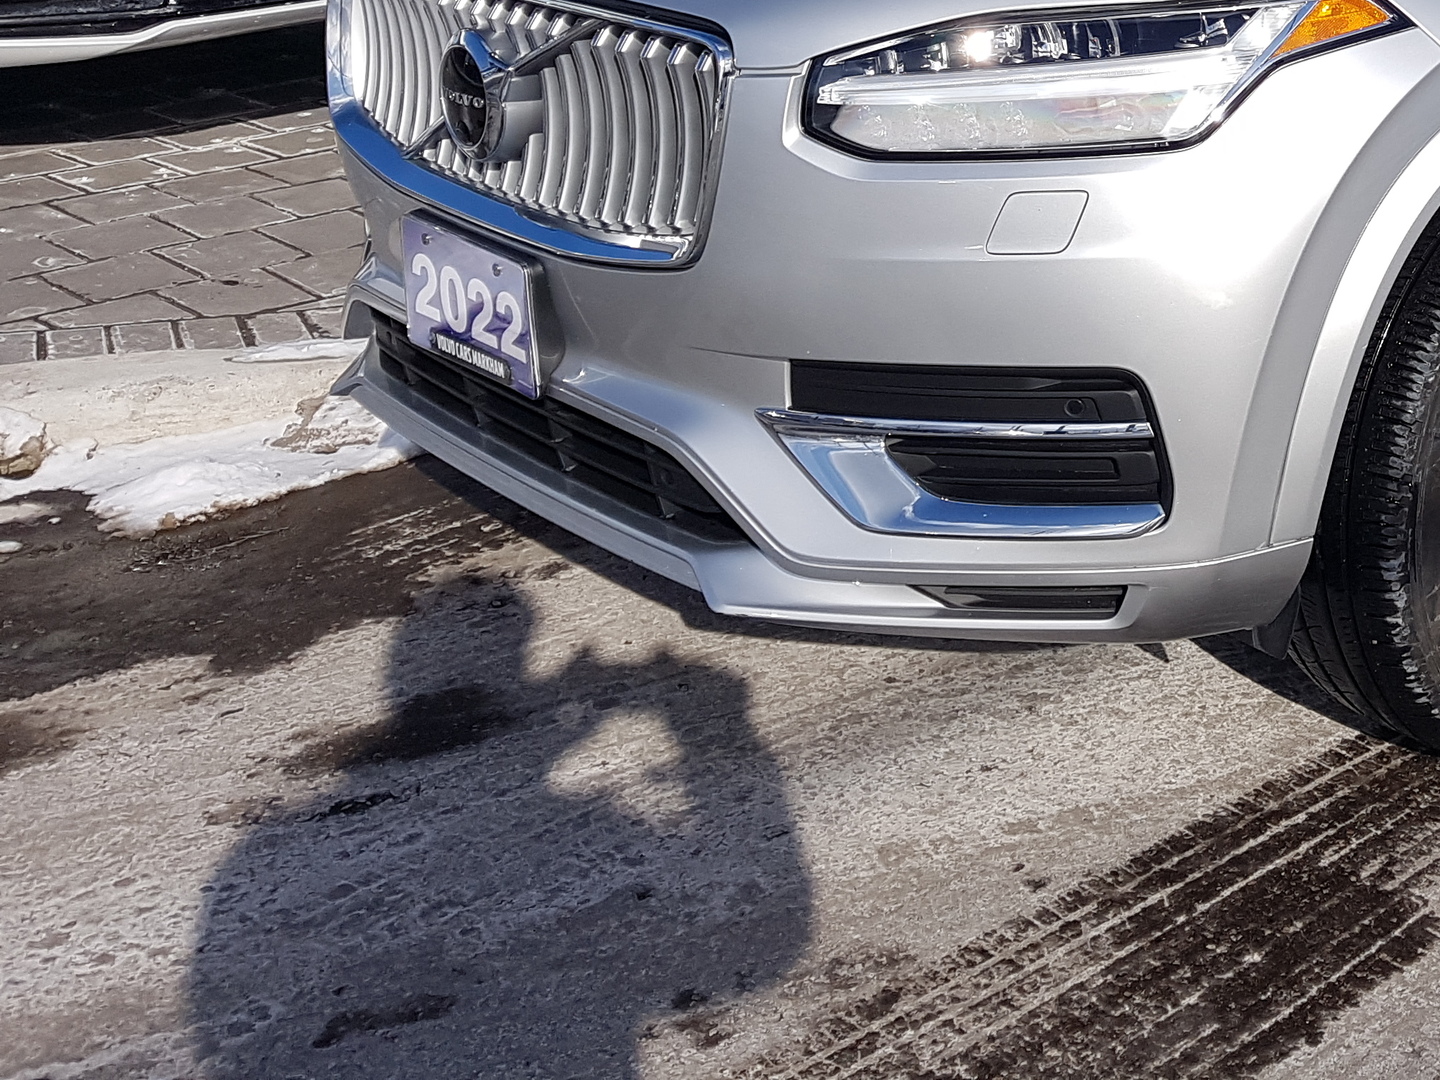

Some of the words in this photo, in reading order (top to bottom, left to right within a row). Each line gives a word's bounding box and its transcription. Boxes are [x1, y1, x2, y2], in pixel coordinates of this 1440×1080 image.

[412, 253, 526, 364] 2022
[436, 333, 456, 356] VOLVO
[455, 342, 472, 364] CARS
[471, 349, 505, 379] MARKHAM
